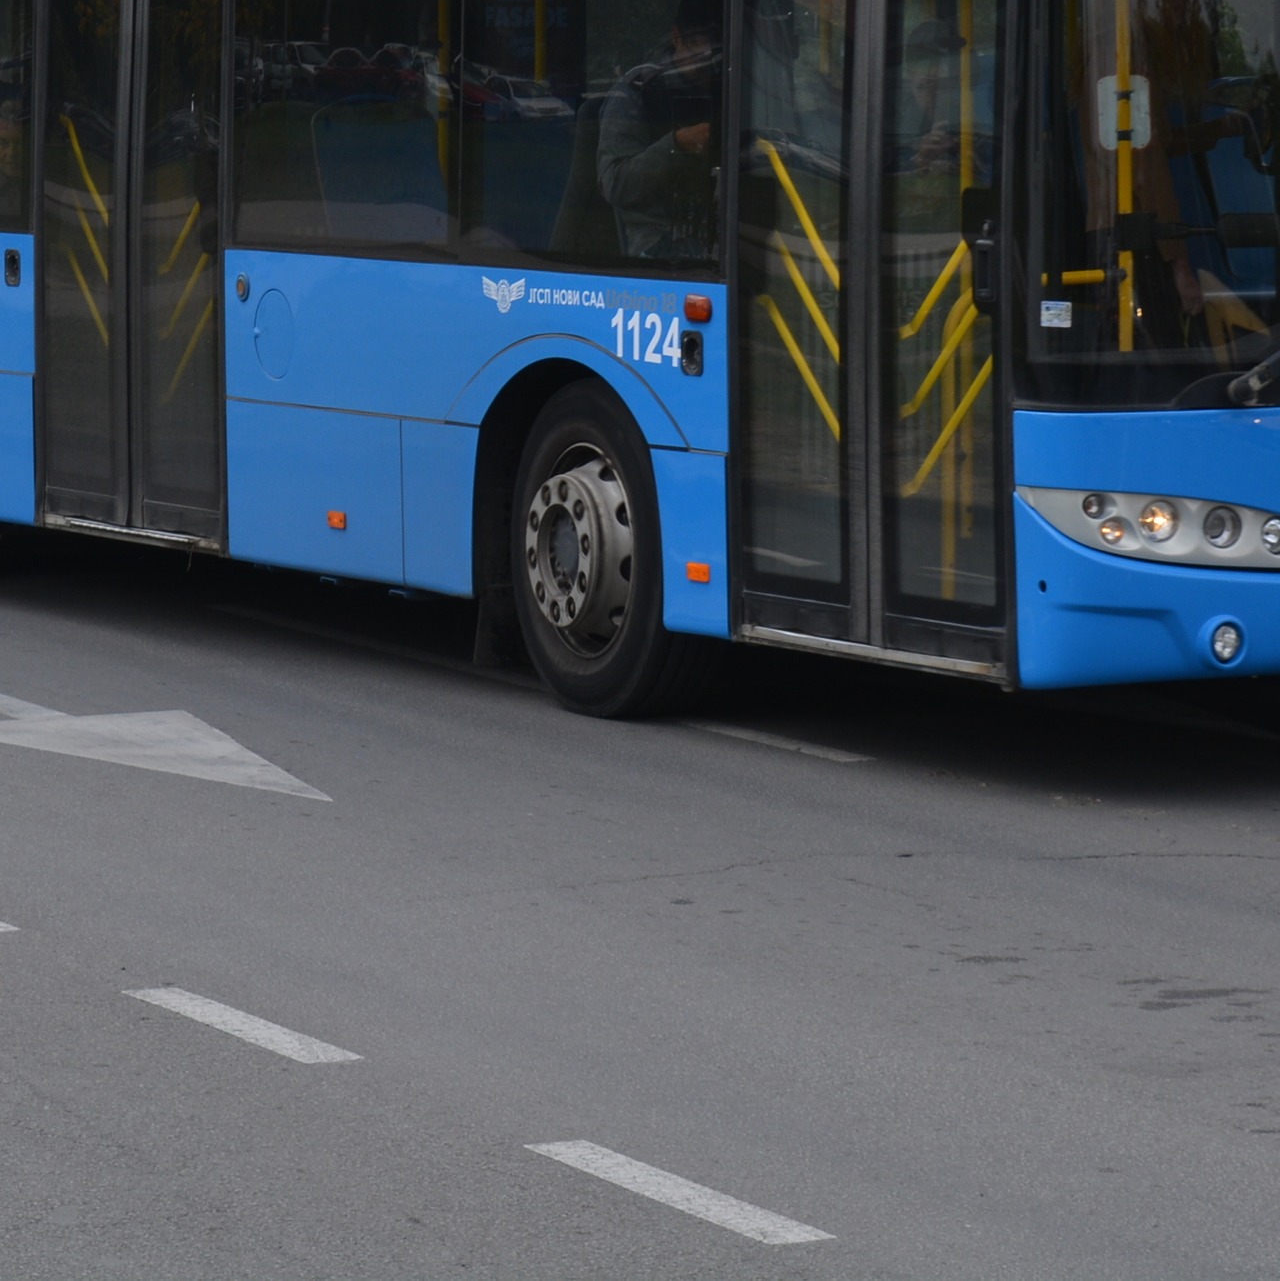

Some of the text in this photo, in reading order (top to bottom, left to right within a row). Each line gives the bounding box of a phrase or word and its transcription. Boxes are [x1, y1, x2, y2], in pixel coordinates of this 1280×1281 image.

[553, 289, 580, 306] НОВИ
[582, 291, 605, 309] САД
[611, 307, 681, 367] 1124
